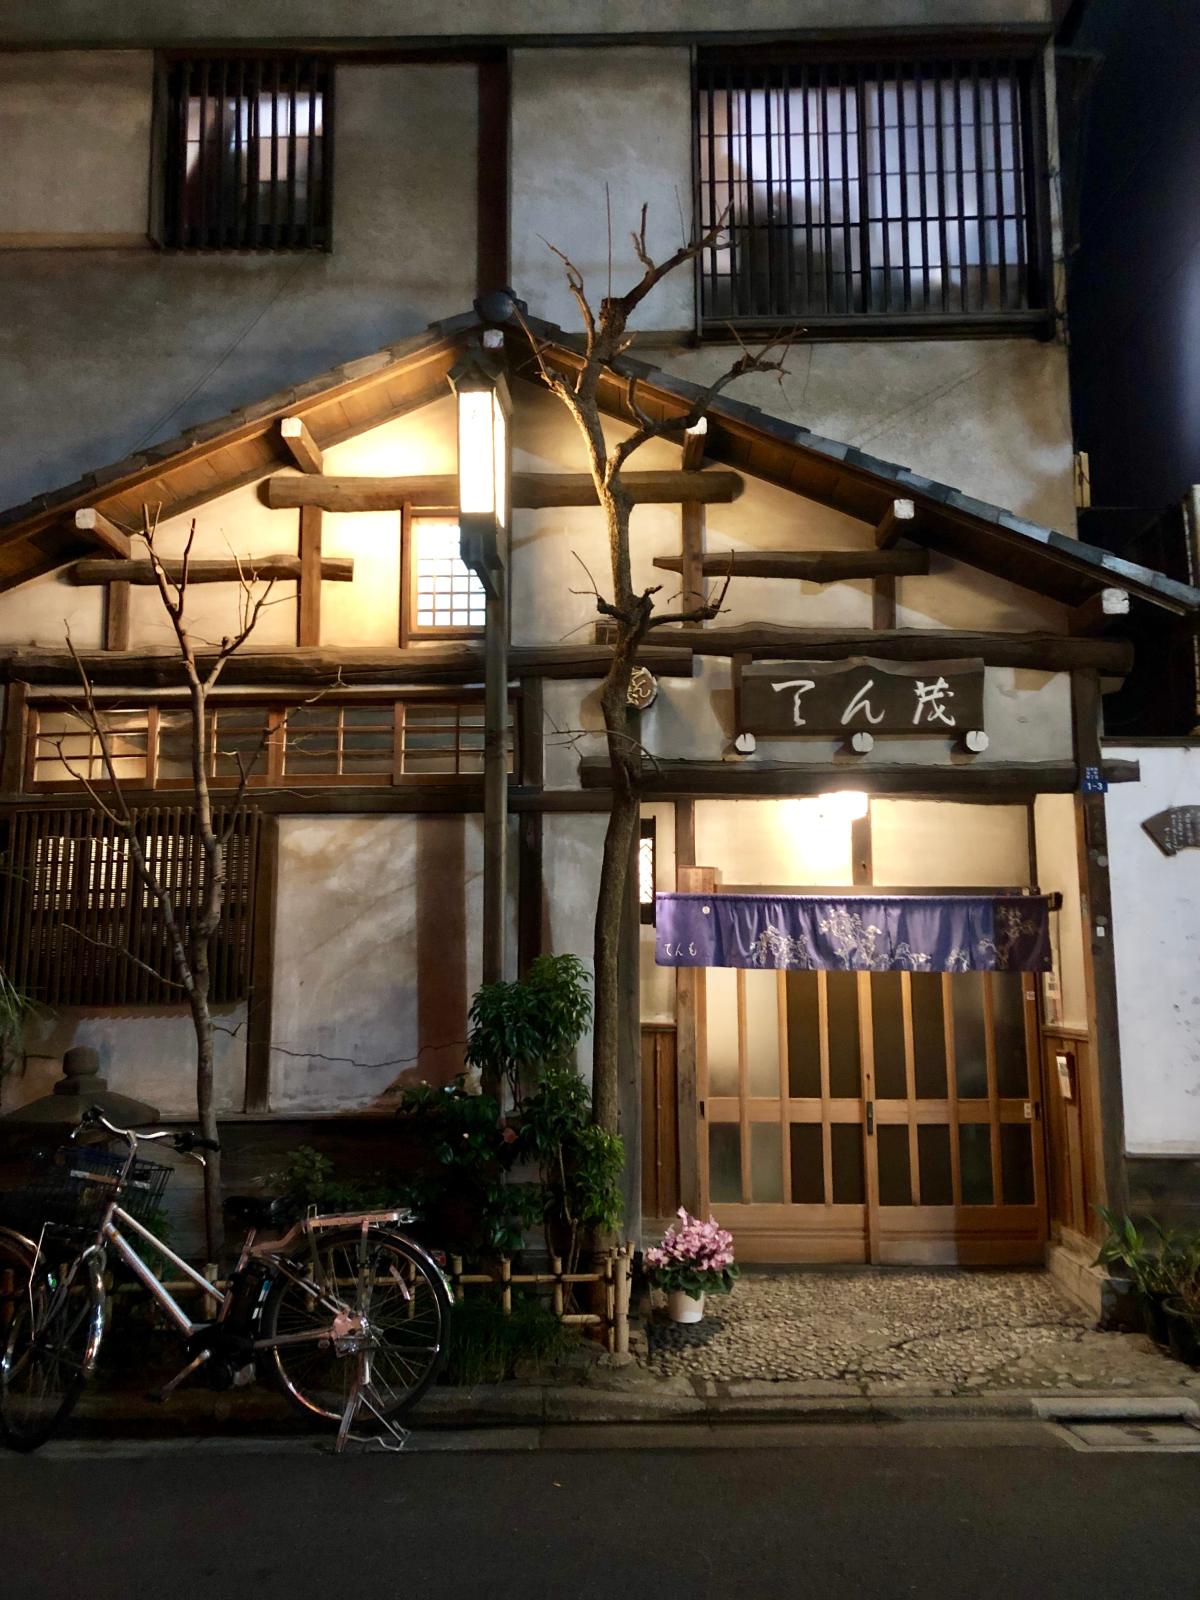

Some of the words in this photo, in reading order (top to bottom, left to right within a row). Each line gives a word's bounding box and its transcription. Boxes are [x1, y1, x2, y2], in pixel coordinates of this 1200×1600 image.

[771, 677, 956, 726] てん茂
[1087, 782, 1103, 791] 1-3
